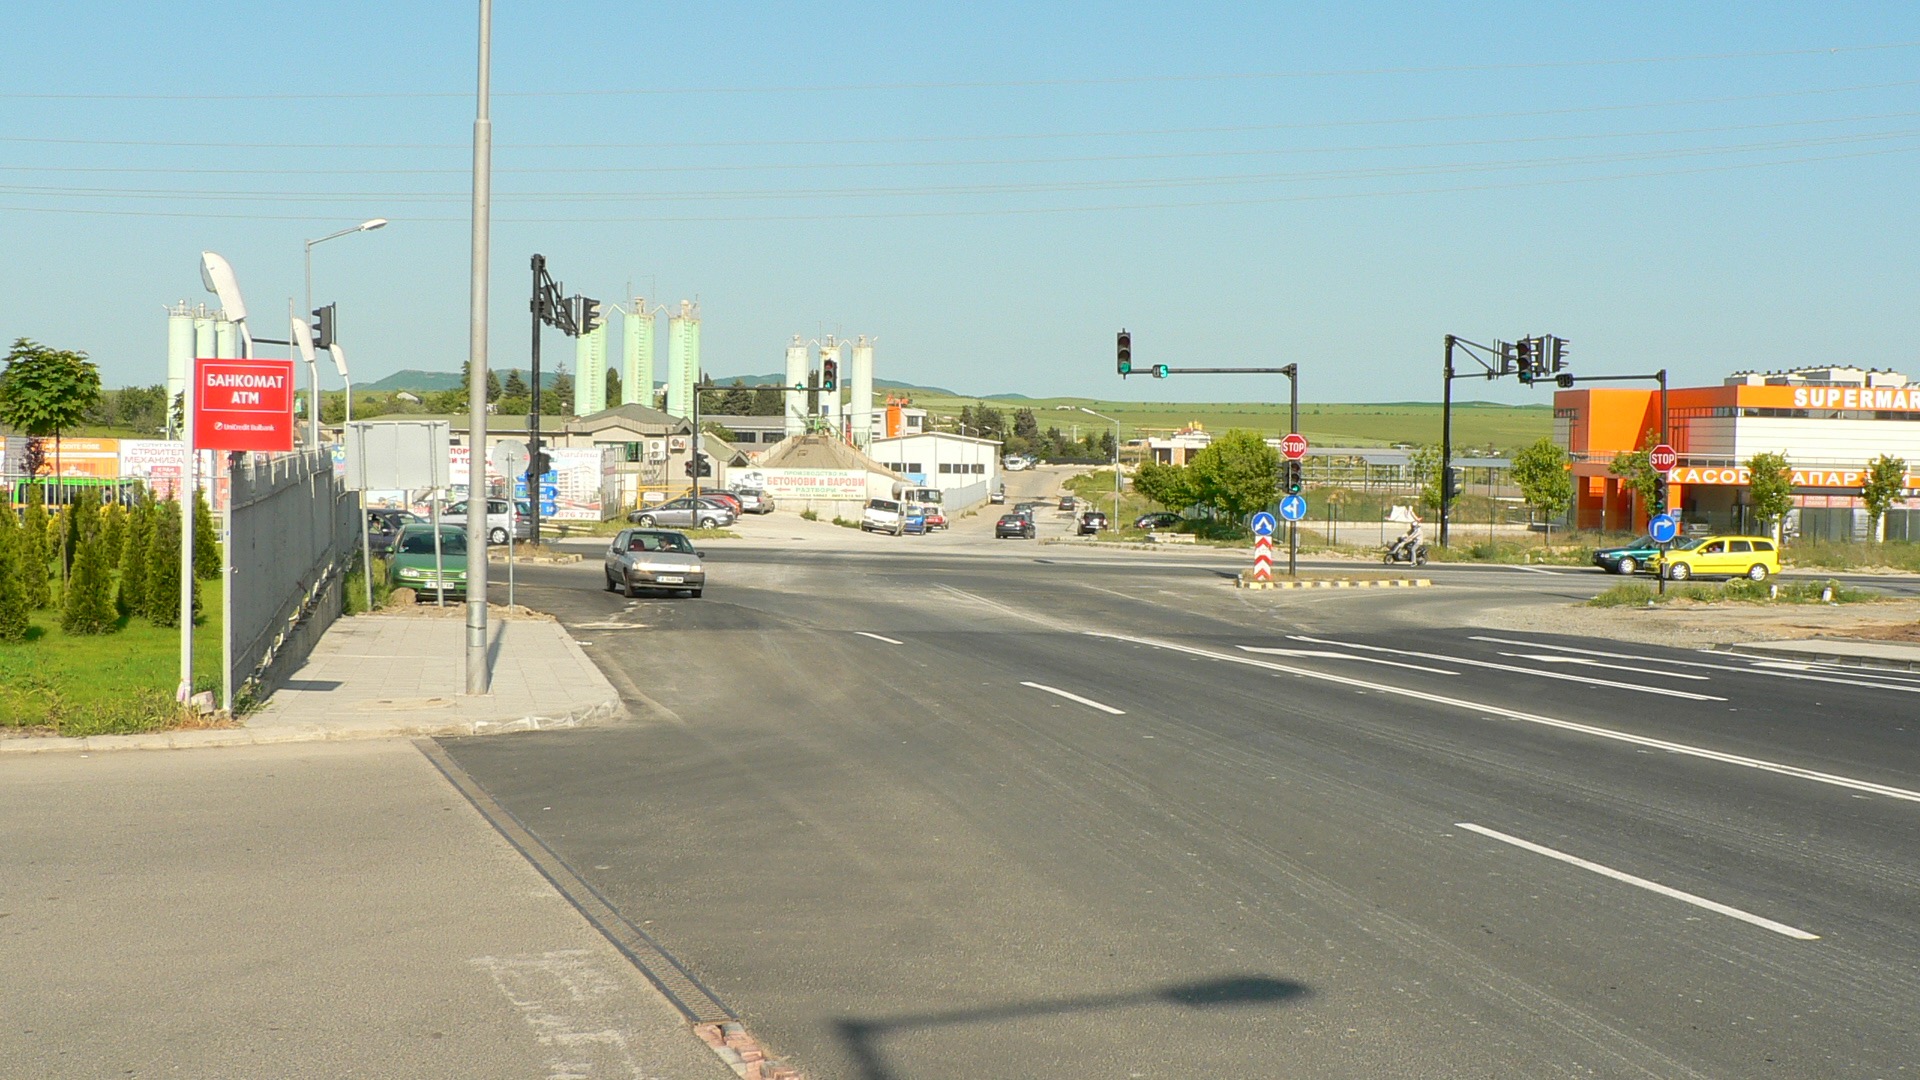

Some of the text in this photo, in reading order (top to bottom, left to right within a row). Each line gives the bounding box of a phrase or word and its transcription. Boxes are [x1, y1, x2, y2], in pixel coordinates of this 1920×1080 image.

[207, 373, 284, 388] БАНКОМАТ
[231, 391, 260, 404] ATM
[1794, 388, 1920, 409] SUPERMAR
[131, 448, 185, 456] СТРОИТЕЛ
[1283, 441, 1304, 453] STOP
[1651, 453, 1675, 465] STOP
[767, 477, 817, 486] БЕТОНОВИ
[827, 478, 865, 487] ВАРОВИ
[1668, 468, 1751, 484] КАСОВ
